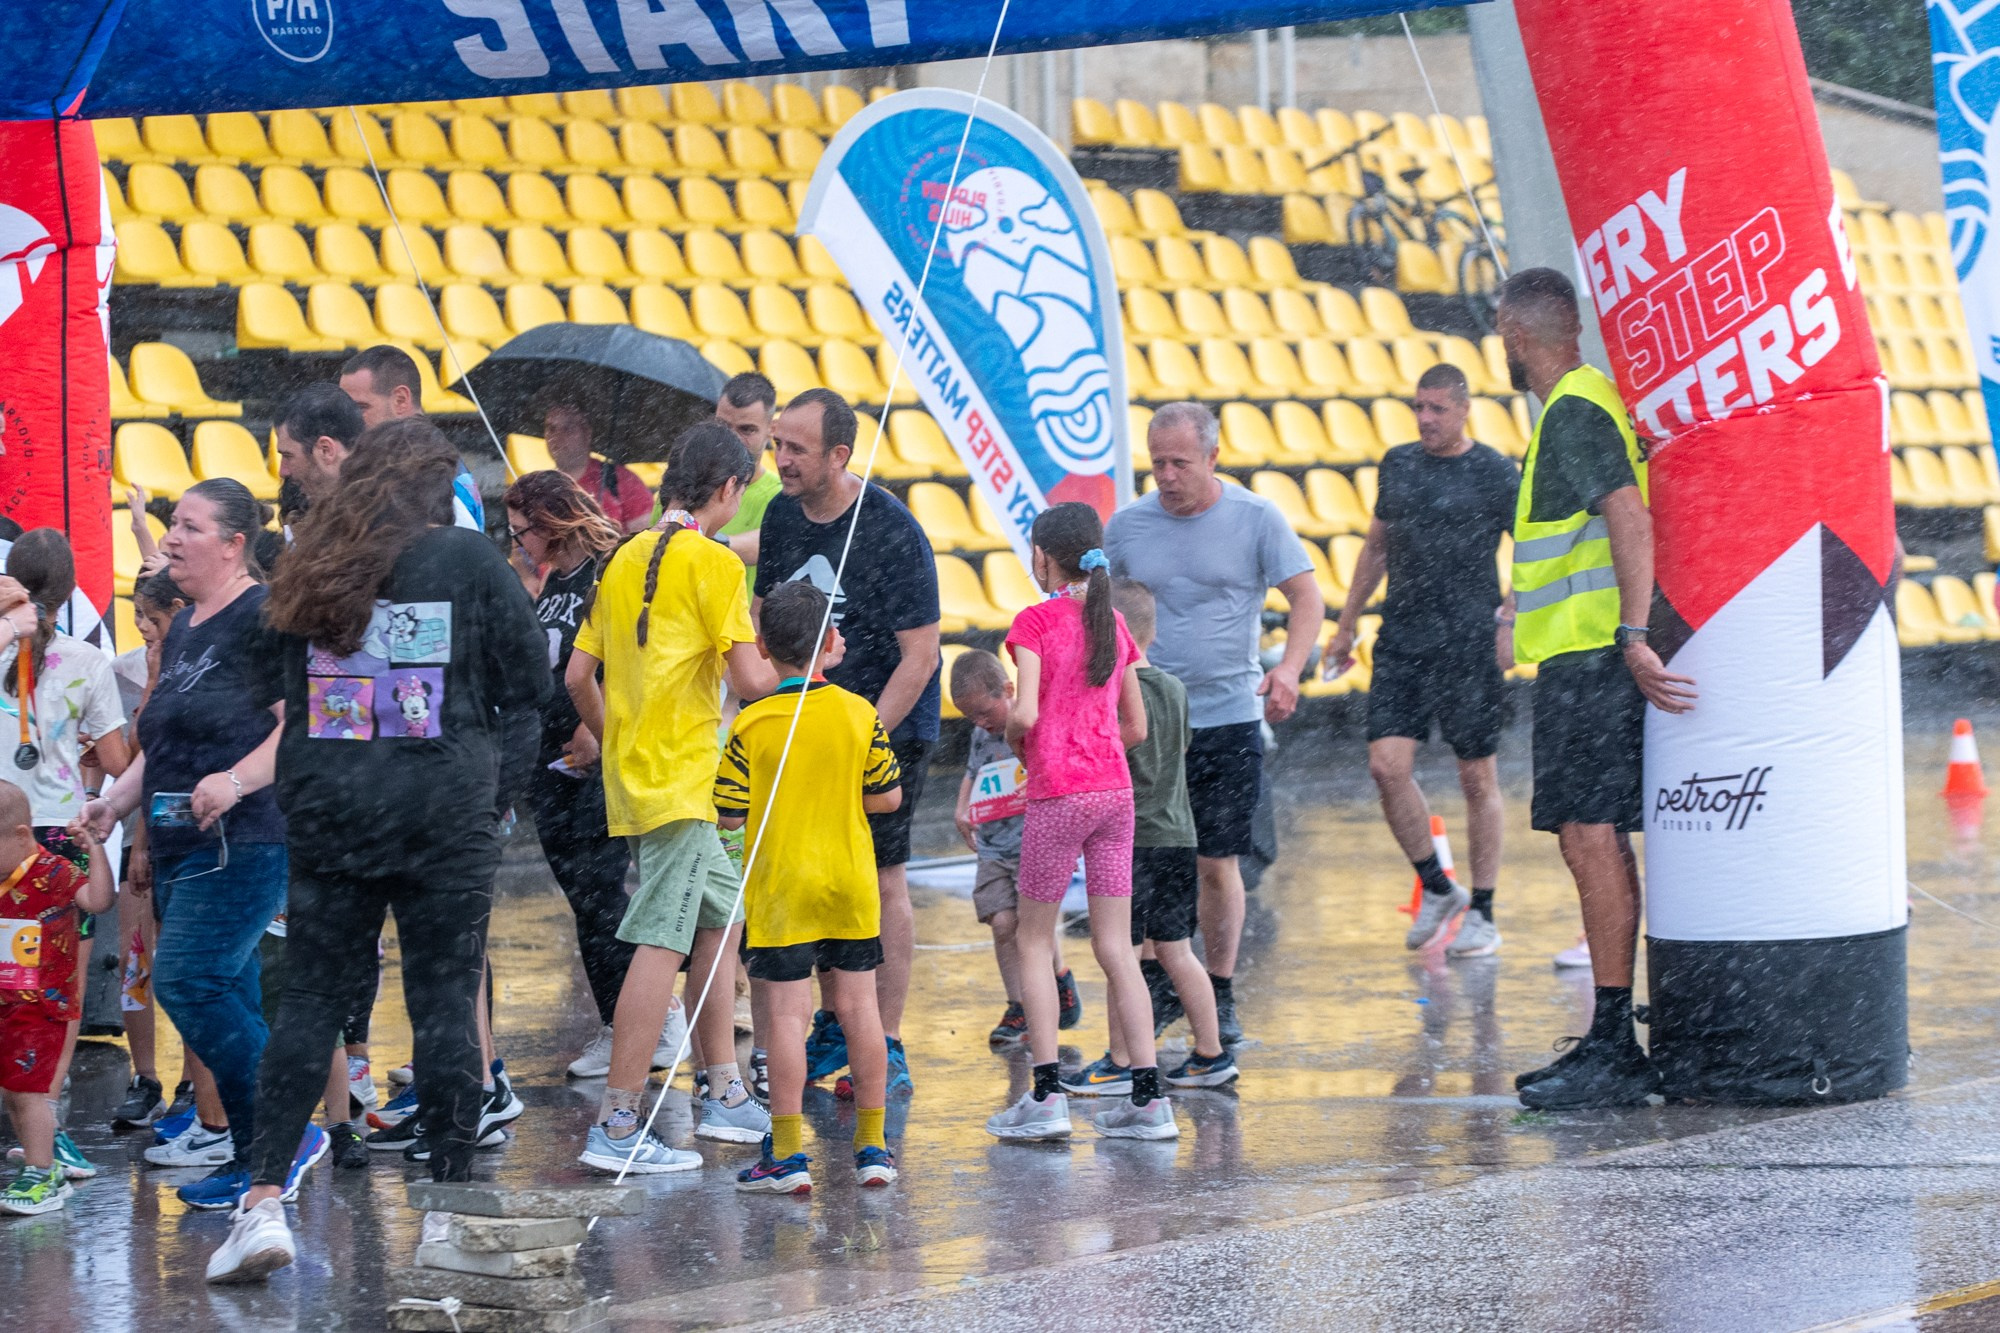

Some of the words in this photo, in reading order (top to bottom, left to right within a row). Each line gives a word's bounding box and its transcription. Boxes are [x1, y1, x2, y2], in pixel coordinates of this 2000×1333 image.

[271, 26, 322, 36] MARKOVO
[1580, 166, 1687, 318] ERY
[1617, 206, 1786, 390] STEP
[980, 774, 1002, 795] 41
[675, 915, 686, 932] CITY
